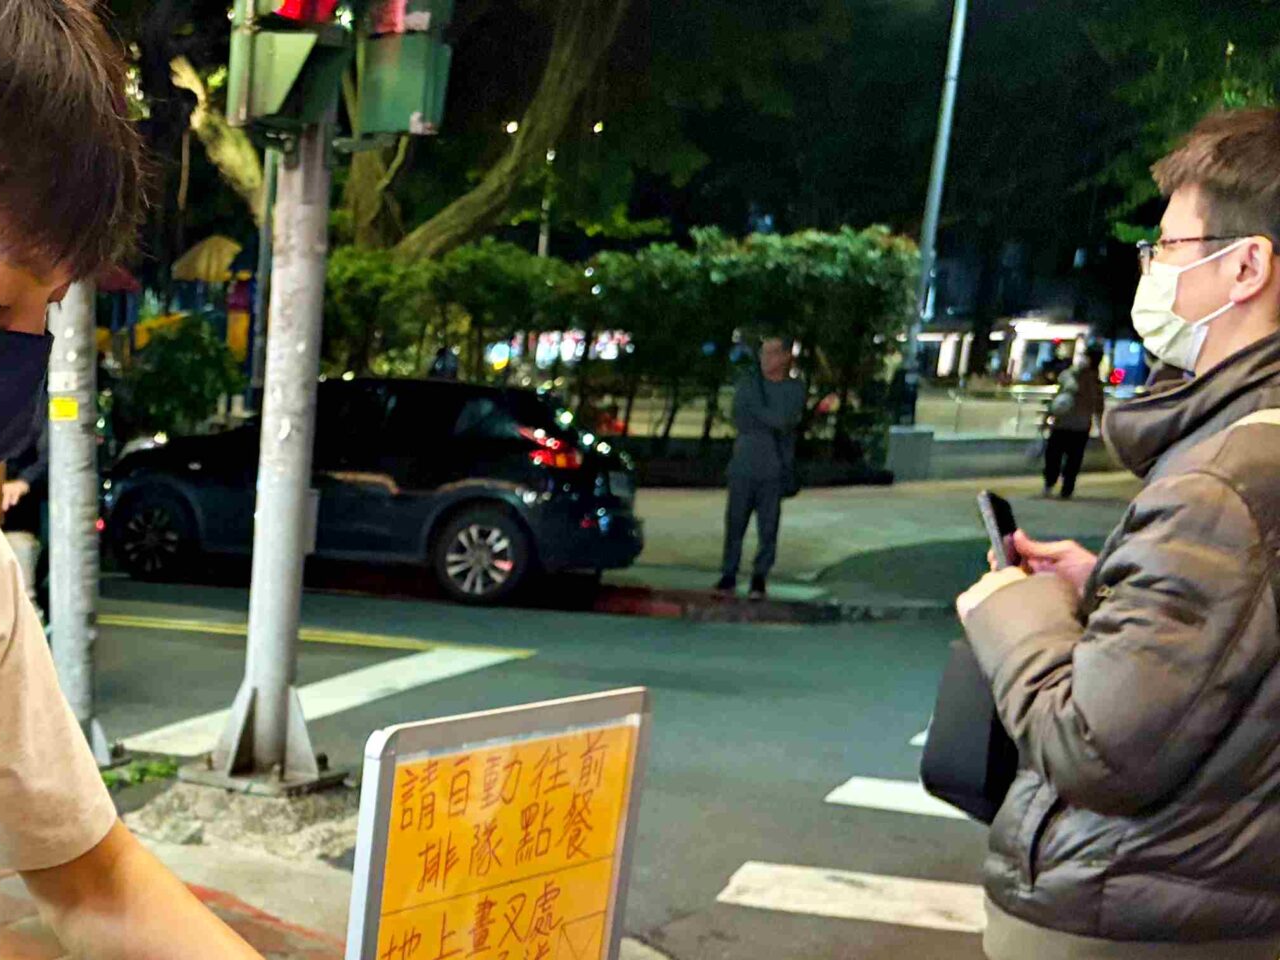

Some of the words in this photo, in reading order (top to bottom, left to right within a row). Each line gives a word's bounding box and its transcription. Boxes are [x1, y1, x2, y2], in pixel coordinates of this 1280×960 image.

[399, 731, 609, 831] 請自動往前
[416, 789, 595, 893] 排隊點餐
